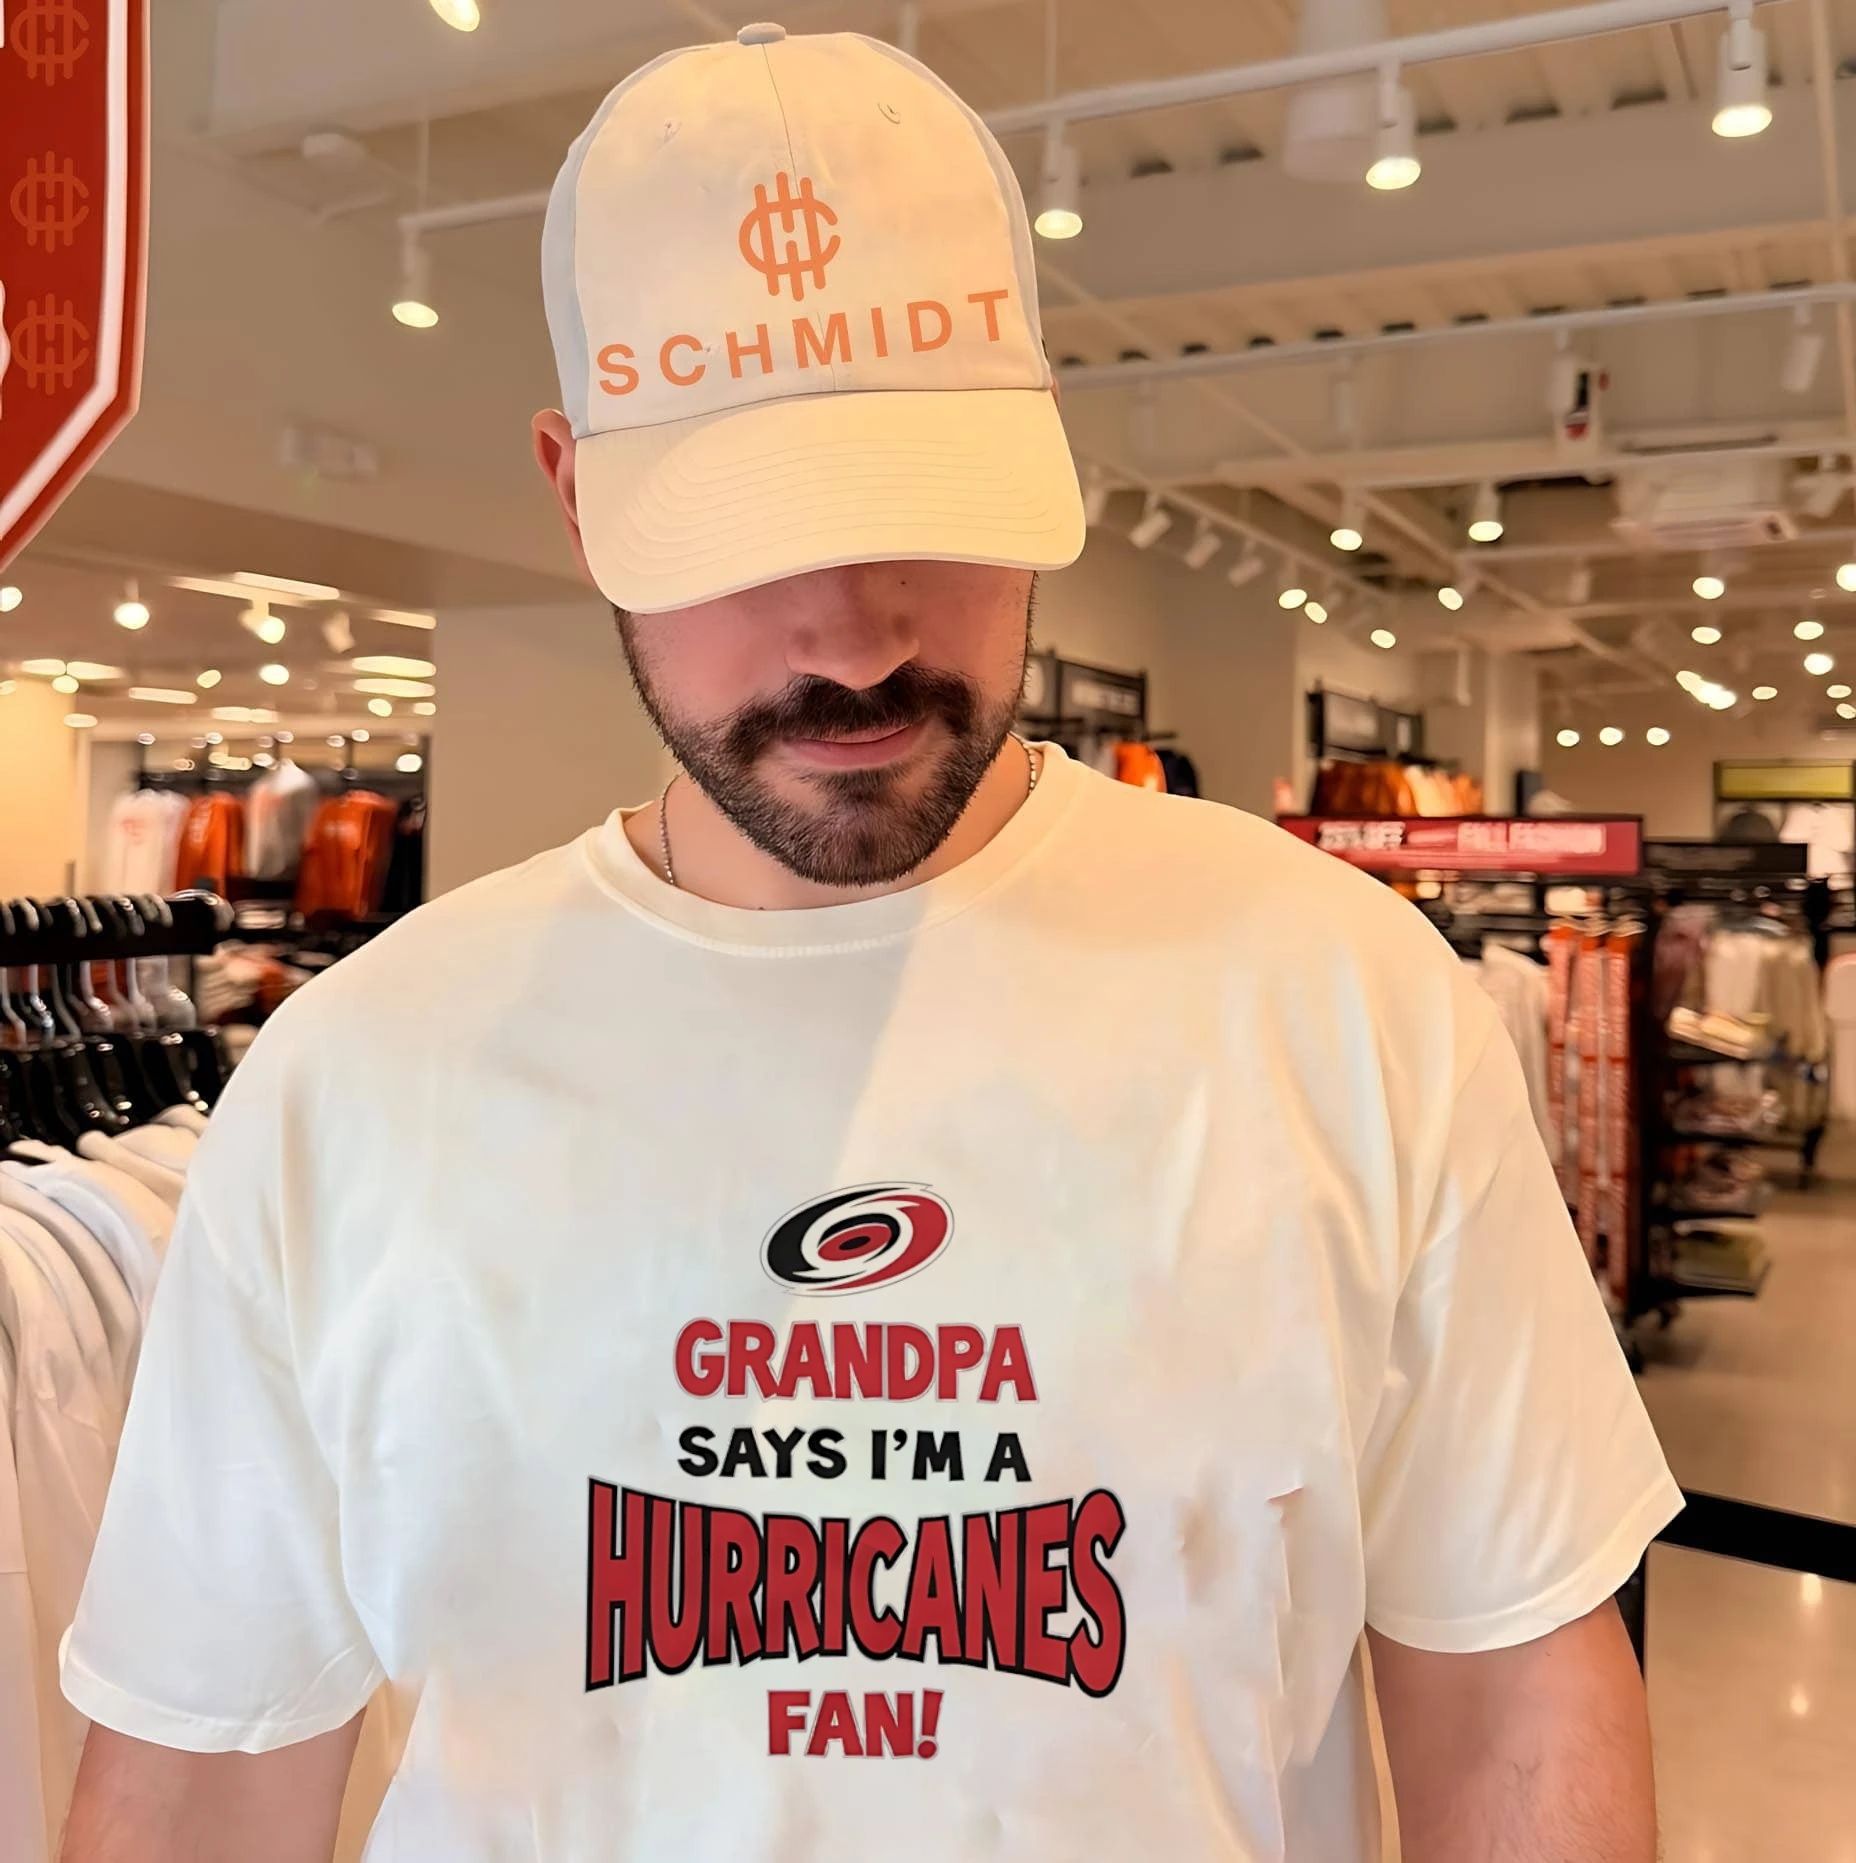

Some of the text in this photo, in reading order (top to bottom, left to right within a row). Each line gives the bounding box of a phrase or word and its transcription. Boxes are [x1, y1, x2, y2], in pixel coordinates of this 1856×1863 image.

[597, 289, 1009, 395] SCHMIDT
[674, 1318, 1038, 1402] GRANDPA
[677, 1425, 847, 1480] SAYS
[984, 1432, 1033, 1483] A
[585, 1477, 1126, 1699] HURRICANES
[767, 1689, 944, 1758] FAN!
